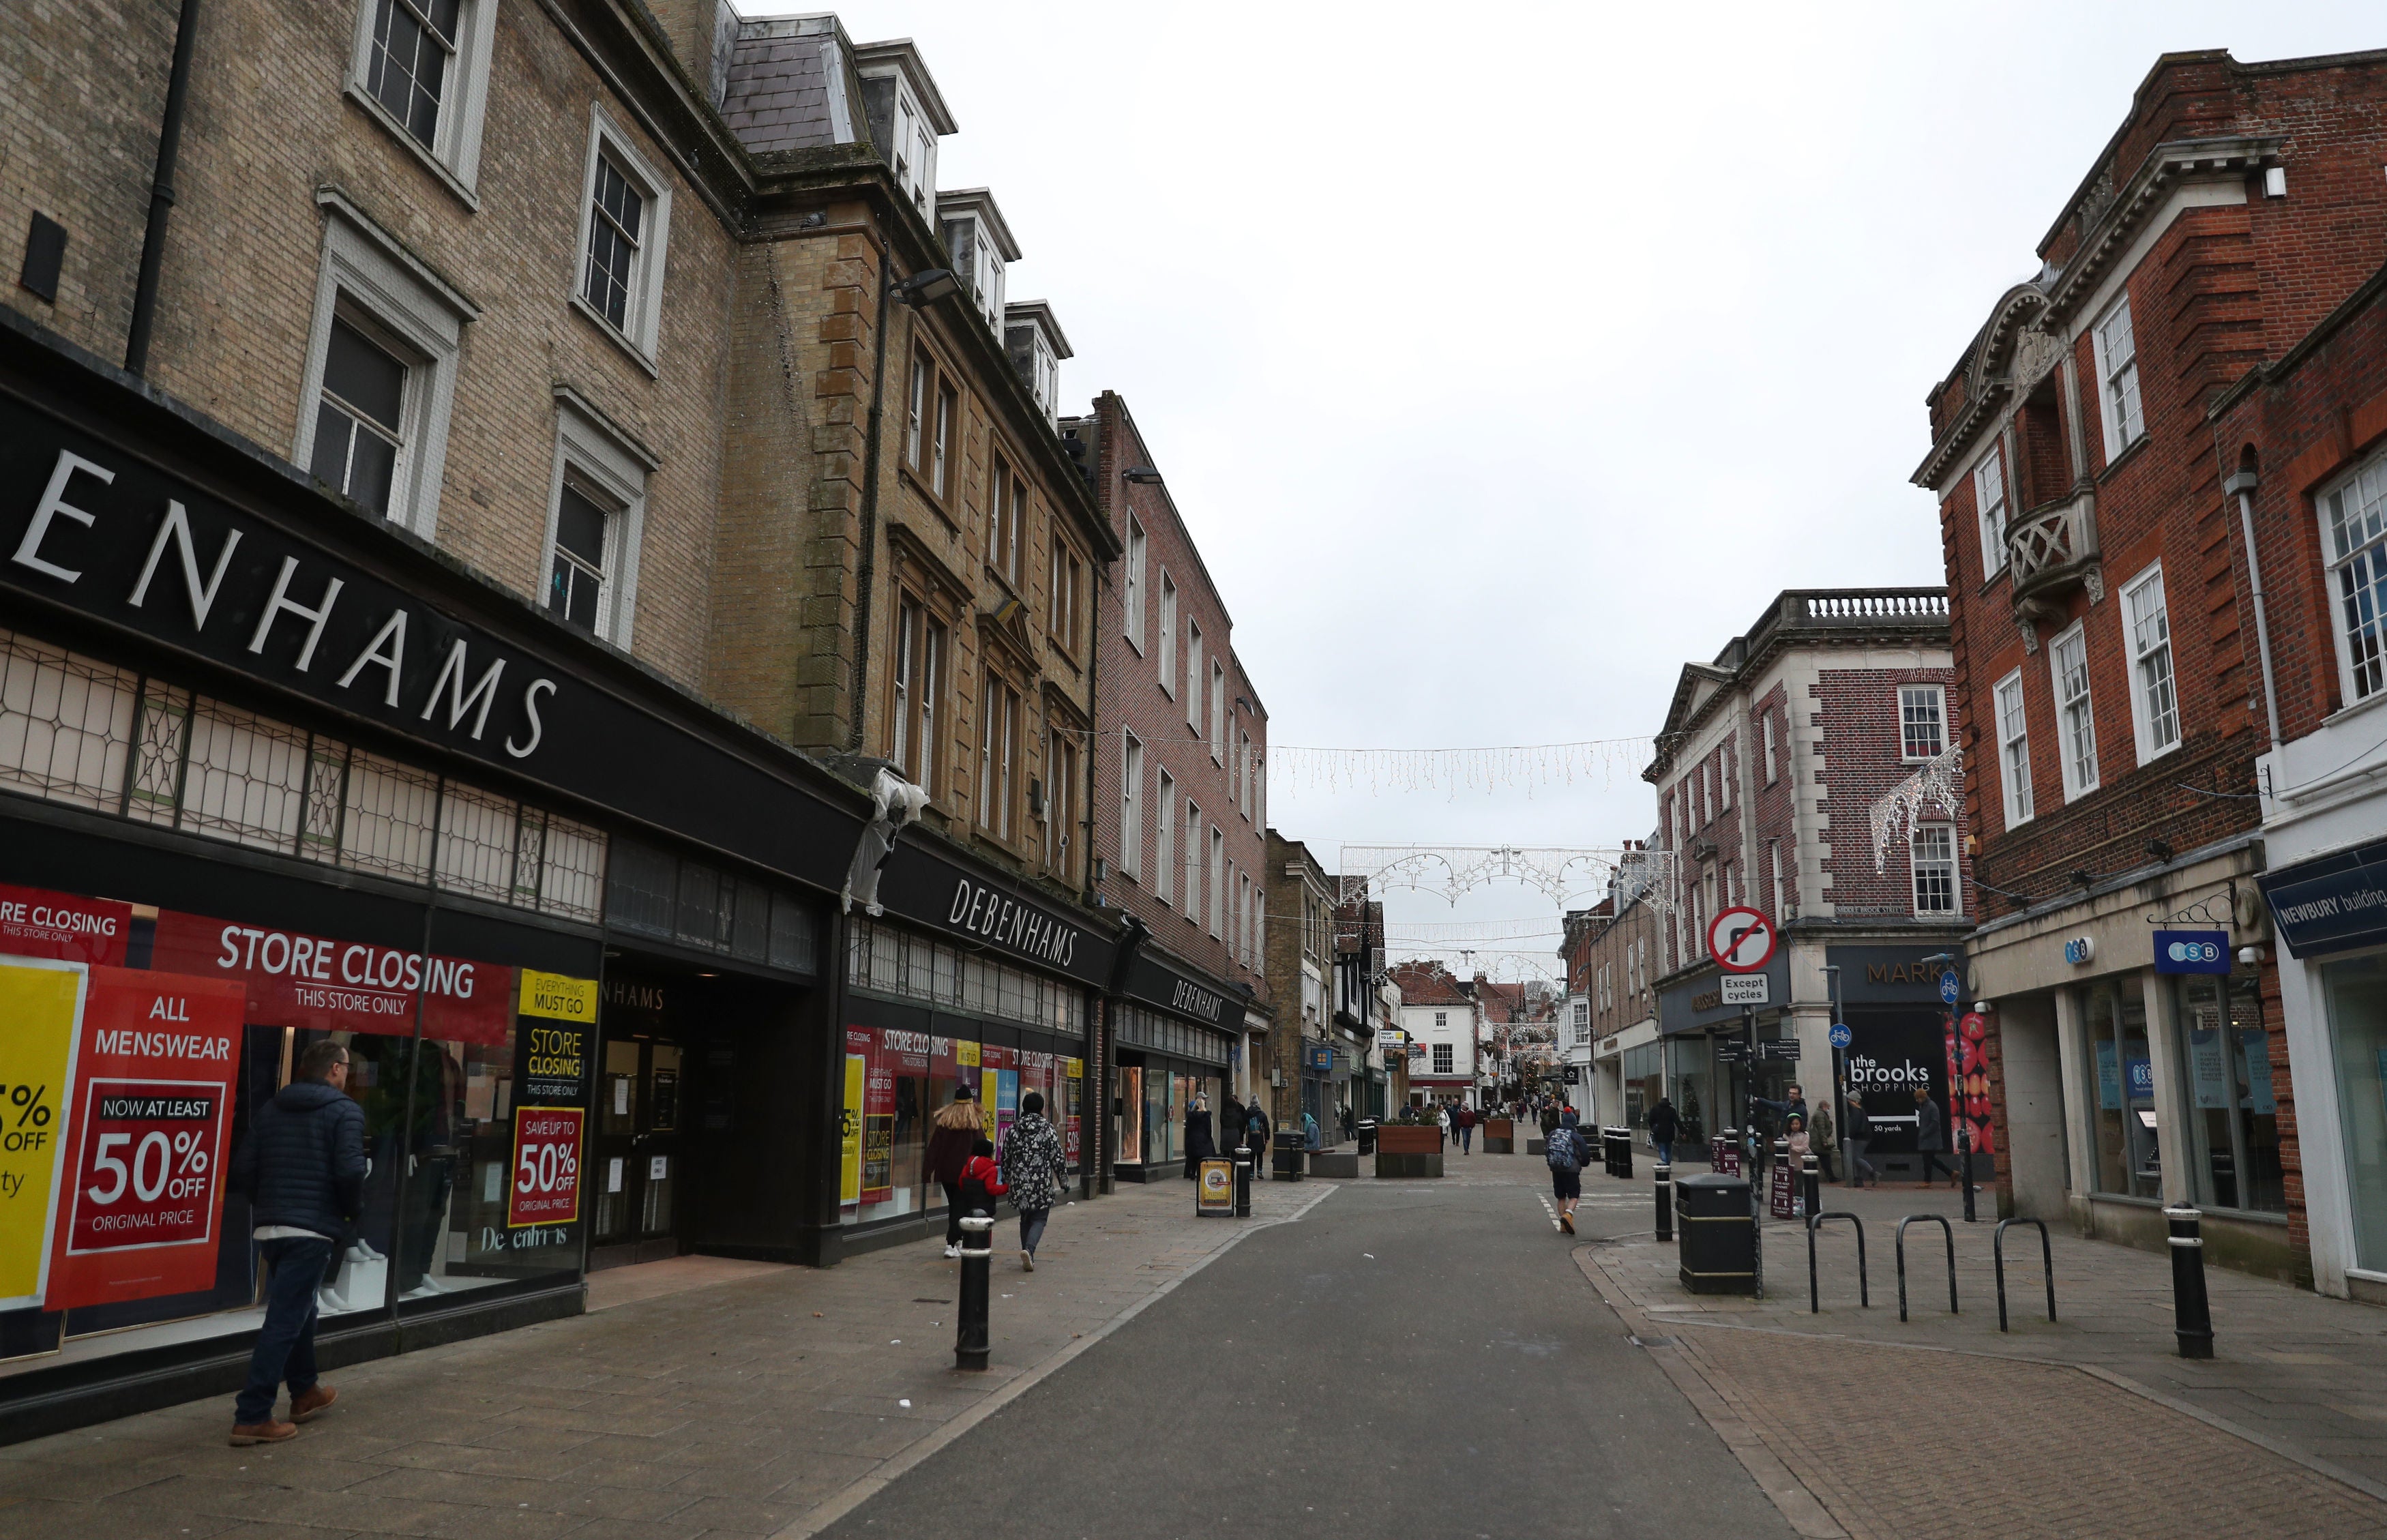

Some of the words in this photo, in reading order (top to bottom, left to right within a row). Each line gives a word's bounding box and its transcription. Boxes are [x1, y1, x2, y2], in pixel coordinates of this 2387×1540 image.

[11, 448, 557, 758] ENHAMS
[1, 901, 27, 923] RE
[32, 906, 117, 936] CLOSING
[2280, 897, 2340, 924] NEWBURY
[949, 878, 1078, 966] DEBENHAMS
[3, 925, 21, 936] THIS
[24, 928, 50, 941] STORE
[51, 932, 74, 943] ONLY
[217, 925, 335, 979] STORE
[342, 945, 475, 998] CLOSING
[535, 978, 584, 997] EVERYTHING
[1725, 978, 1764, 988] Except
[295, 988, 325, 1008] THIS
[329, 993, 370, 1013] STORE
[372, 996, 407, 1016] ONLY
[534, 993, 565, 1011] MUST
[567, 999, 584, 1013] GO
[1172, 979, 1223, 1022] DEBENHAMS
[1728, 990, 1762, 1001] cycles
[149, 996, 190, 1022] ALL
[95, 1029, 231, 1060] MENSWEAR
[530, 1028, 582, 1056] STORE
[854, 1032, 871, 1043] CLOSING
[885, 1028, 912, 1052] STORE
[913, 1033, 949, 1056] CLOSING
[529, 1056, 580, 1076] CLOSING
[1032, 1052, 1053, 1069] CLOSING
[1850, 1058, 1929, 1082] brooks
[1856, 1054, 1876, 1067] the
[527, 1084, 541, 1094] THIS
[542, 1085, 561, 1095] STORE
[562, 1086, 578, 1096] ONLY
[870, 1078, 883, 1089] MUST
[883, 1078, 892, 1089] GO
[1852, 1082, 1930, 1092] SHOPPING
[104, 1100, 143, 1116] NOW
[145, 1101, 165, 1116] AT
[167, 1101, 210, 1117] LEAST
[526, 1121, 549, 1135] SAVE
[549, 1121, 563, 1135] UP
[563, 1121, 575, 1135] TO
[1884, 1125, 1901, 1133] yards
[4, 1132, 48, 1151] OFF
[868, 1130, 890, 1147] STORE
[867, 1147, 889, 1160] CLOSING
[87, 1129, 208, 1205] 50%
[518, 1142, 576, 1193] 50%
[1, 1170, 25, 1198] ty
[168, 1177, 206, 1199] OFF
[557, 1176, 575, 1191] OFF
[520, 1200, 552, 1211] ORIGINAL
[552, 1198, 570, 1209] PRICE
[93, 1213, 156, 1232] ORIGINAL
[159, 1210, 194, 1227] PRICE
